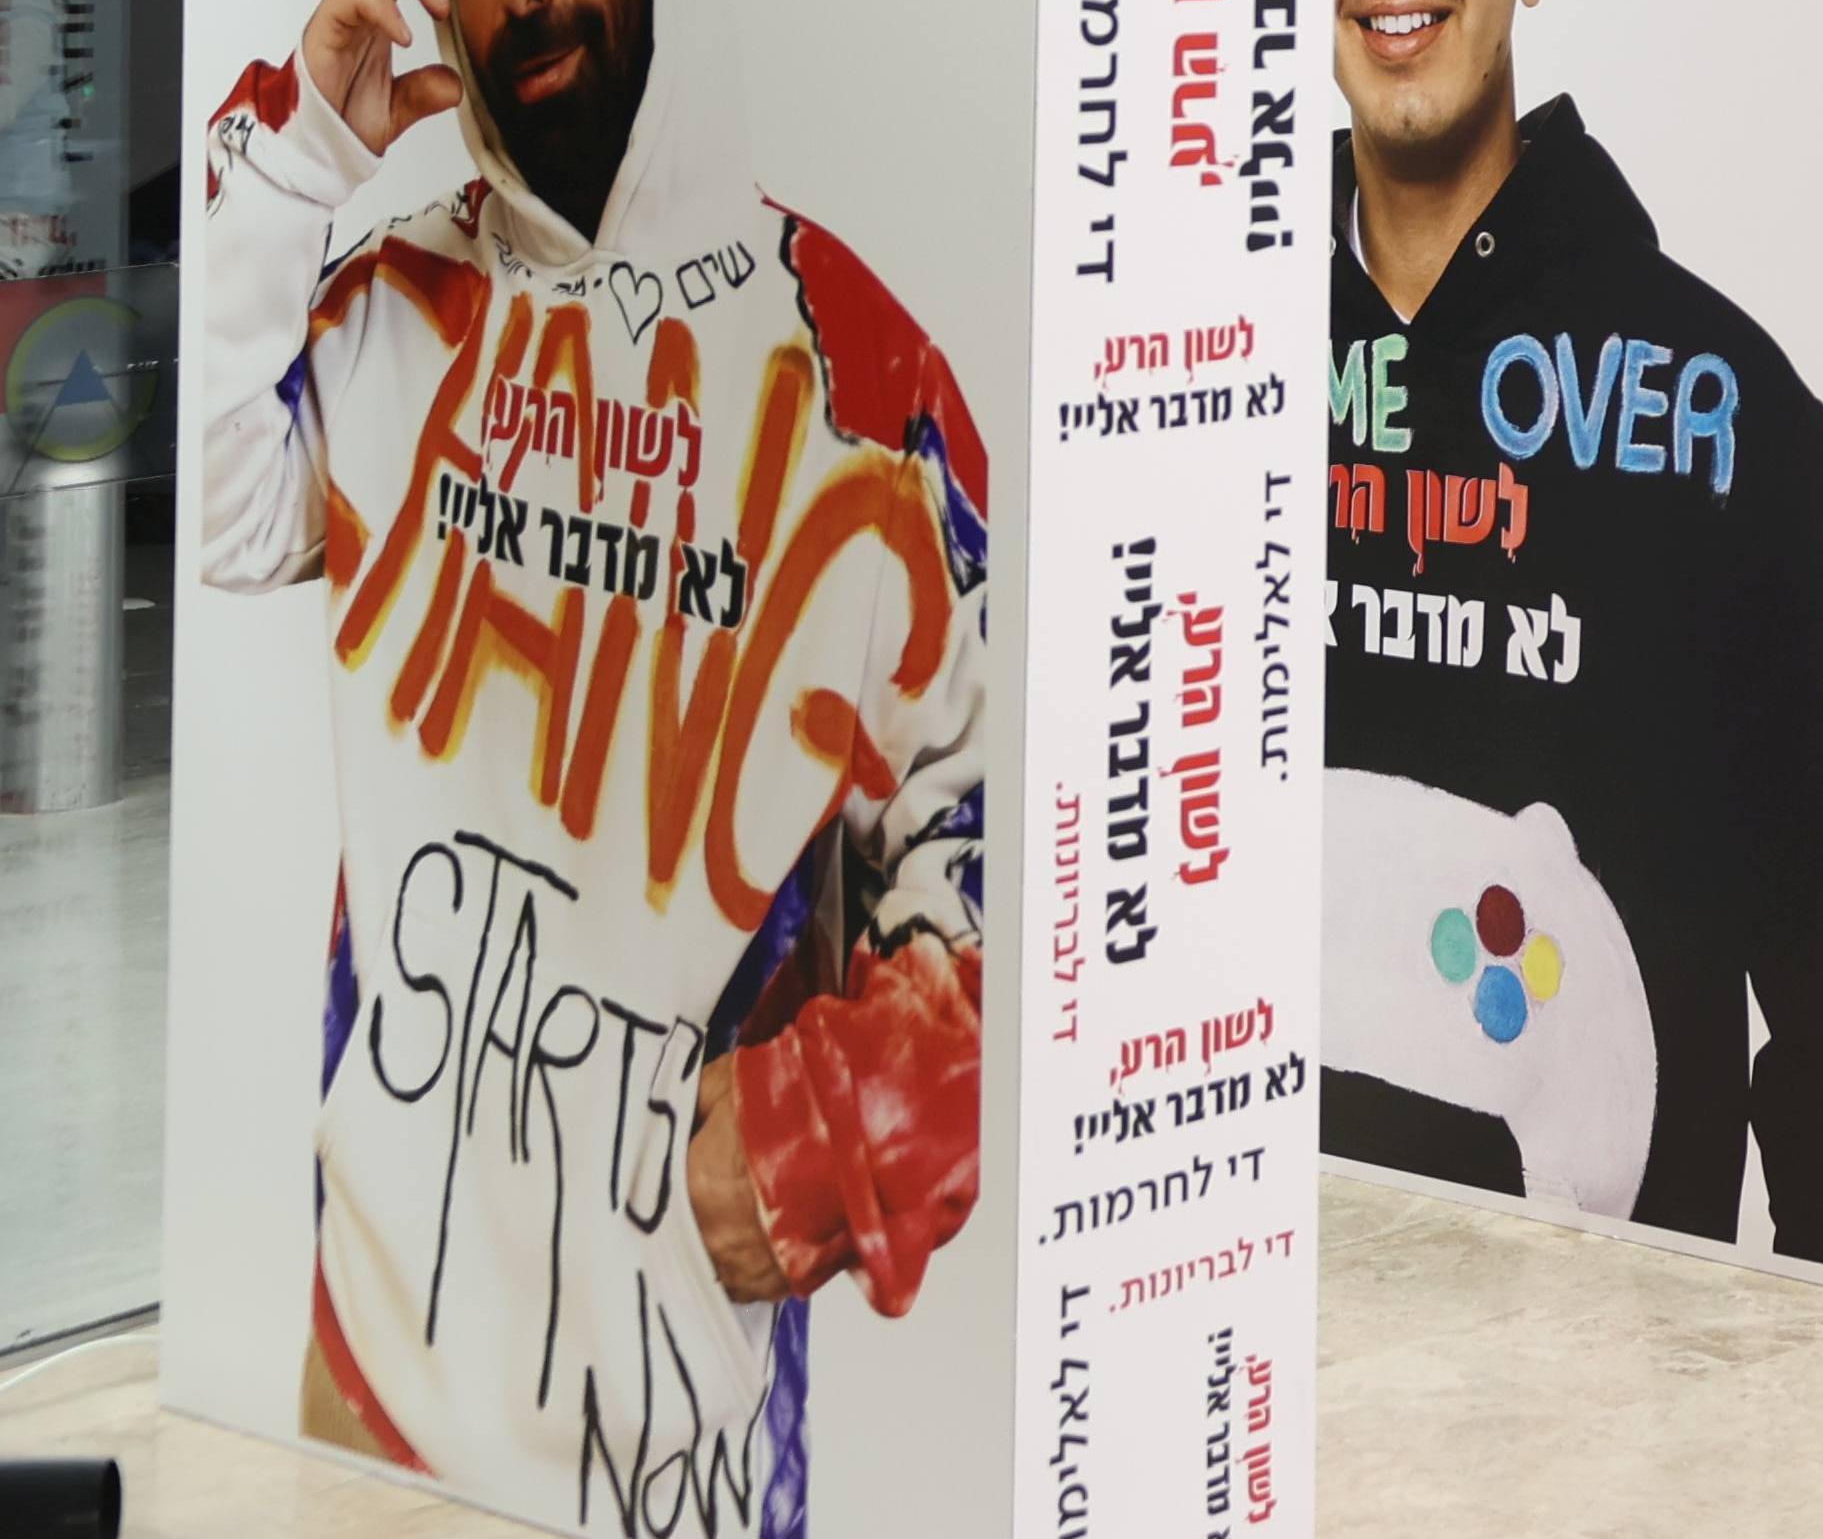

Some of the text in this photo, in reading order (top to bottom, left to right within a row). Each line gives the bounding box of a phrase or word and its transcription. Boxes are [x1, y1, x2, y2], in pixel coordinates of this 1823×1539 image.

[594, 398, 702, 500] לשון
[1481, 332, 1740, 500] OVER
[542, 508, 658, 599] מדבר
[1407, 462, 1528, 575] לשון
[679, 539, 748, 629] לא
[1351, 583, 1581, 684] לא מדבר
